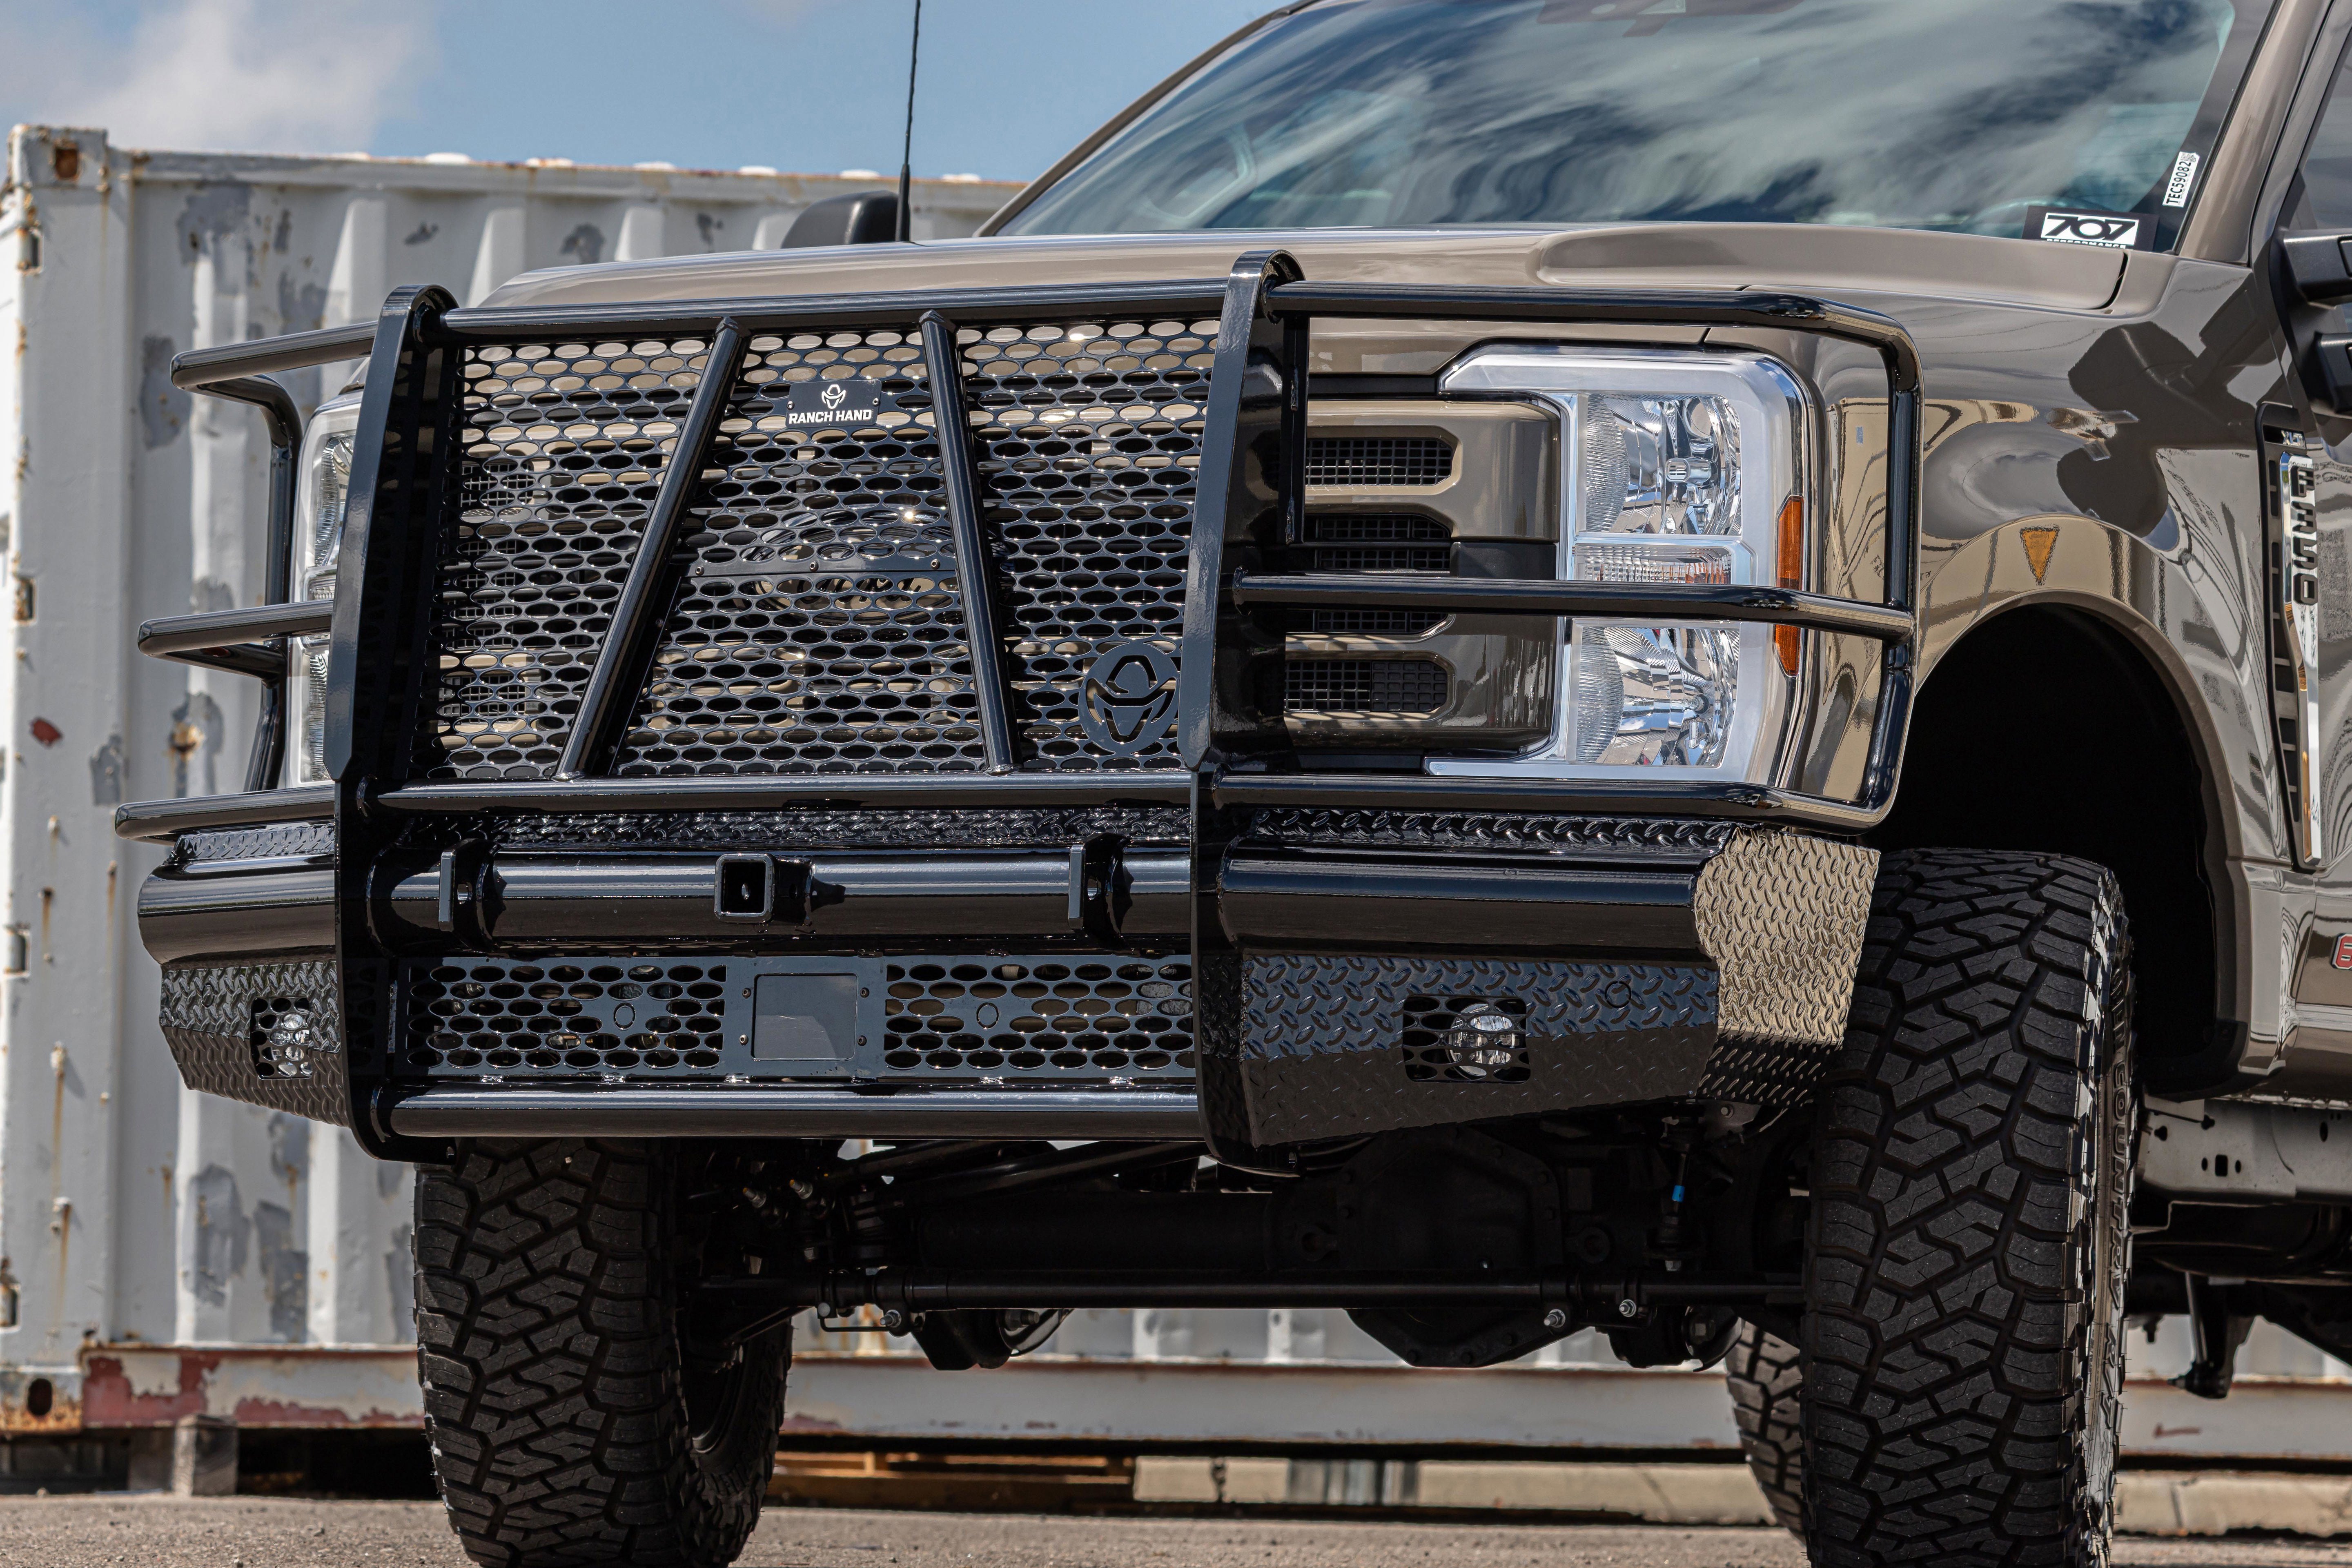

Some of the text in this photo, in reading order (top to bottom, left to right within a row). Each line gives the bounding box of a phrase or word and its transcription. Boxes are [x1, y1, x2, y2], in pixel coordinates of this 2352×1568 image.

[2166, 161, 2192, 204] TEC59082
[2045, 215, 2136, 241] 707
[788, 410, 872, 424] RANCH HAND
[2109, 1061, 2126, 1310] COUNTRY
